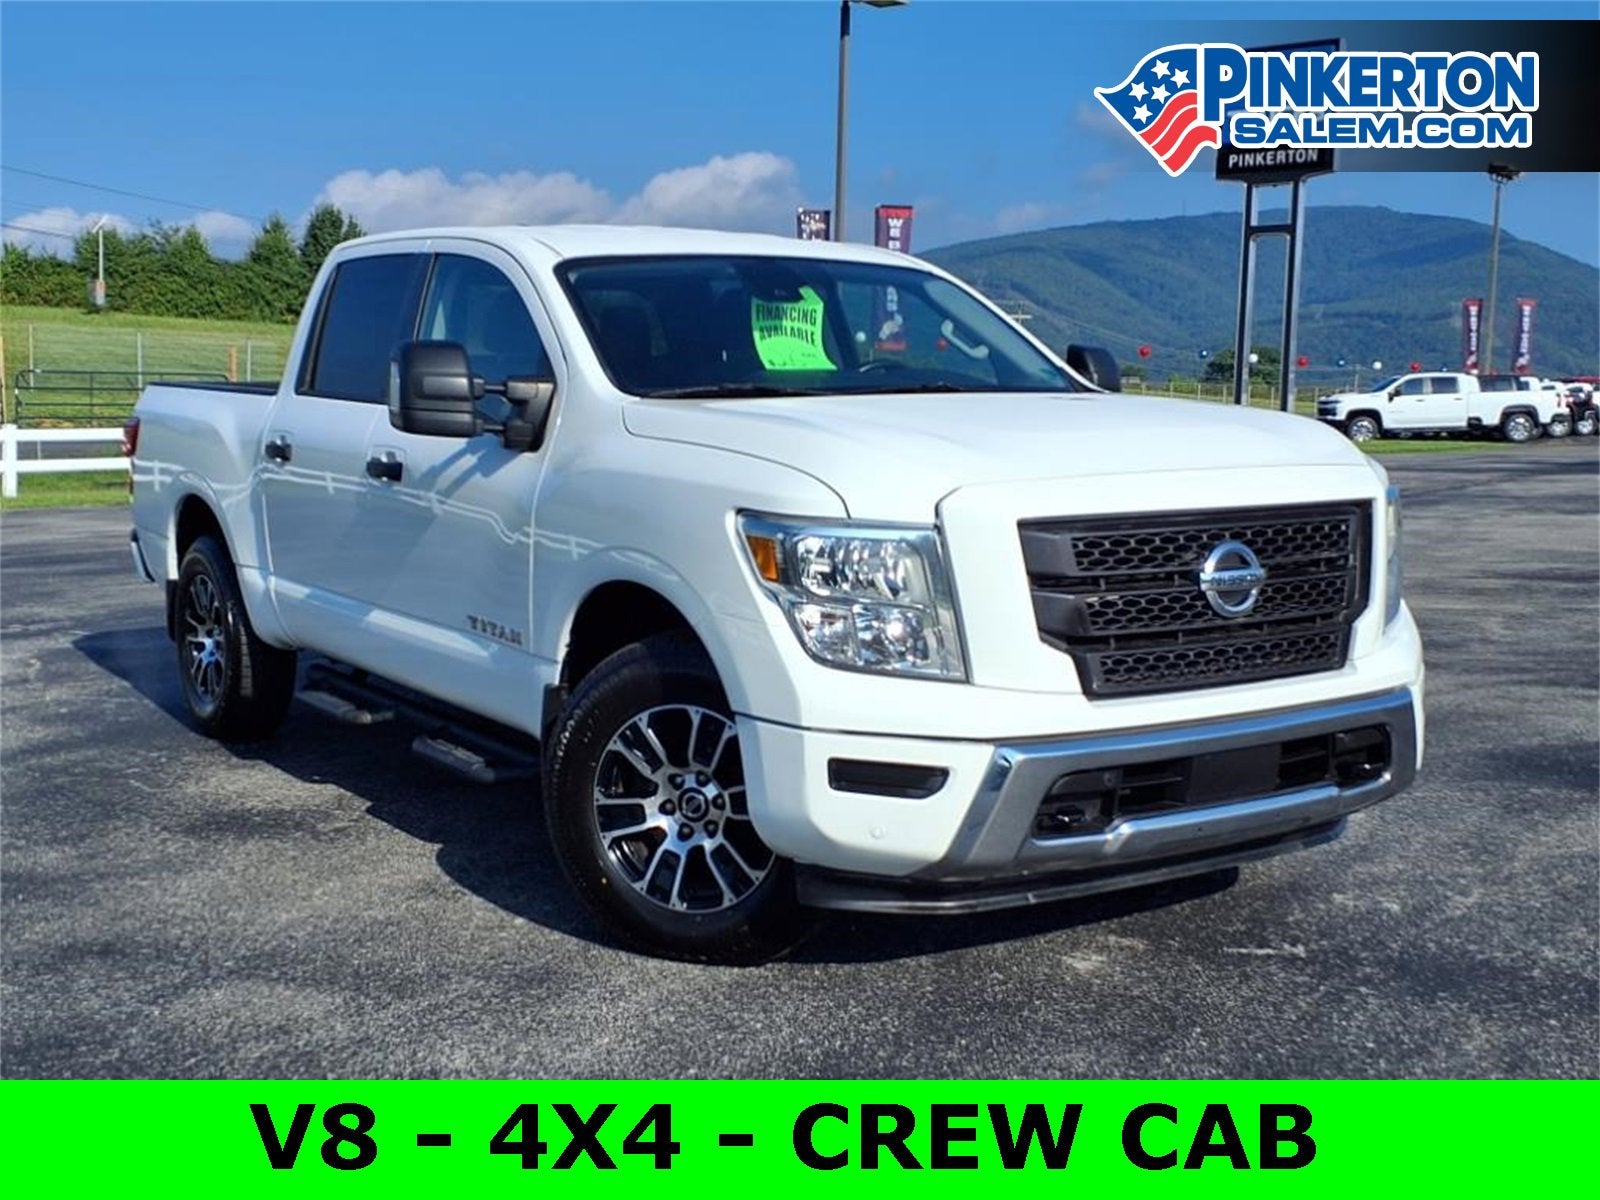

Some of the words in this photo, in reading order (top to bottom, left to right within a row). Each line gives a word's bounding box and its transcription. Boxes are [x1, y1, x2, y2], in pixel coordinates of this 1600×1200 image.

[1227, 148, 1320, 169] PINKERTON
[755, 303, 818, 328] FINANCING
[758, 324, 817, 348] AVAILABLE
[465, 613, 524, 647] TITAN
